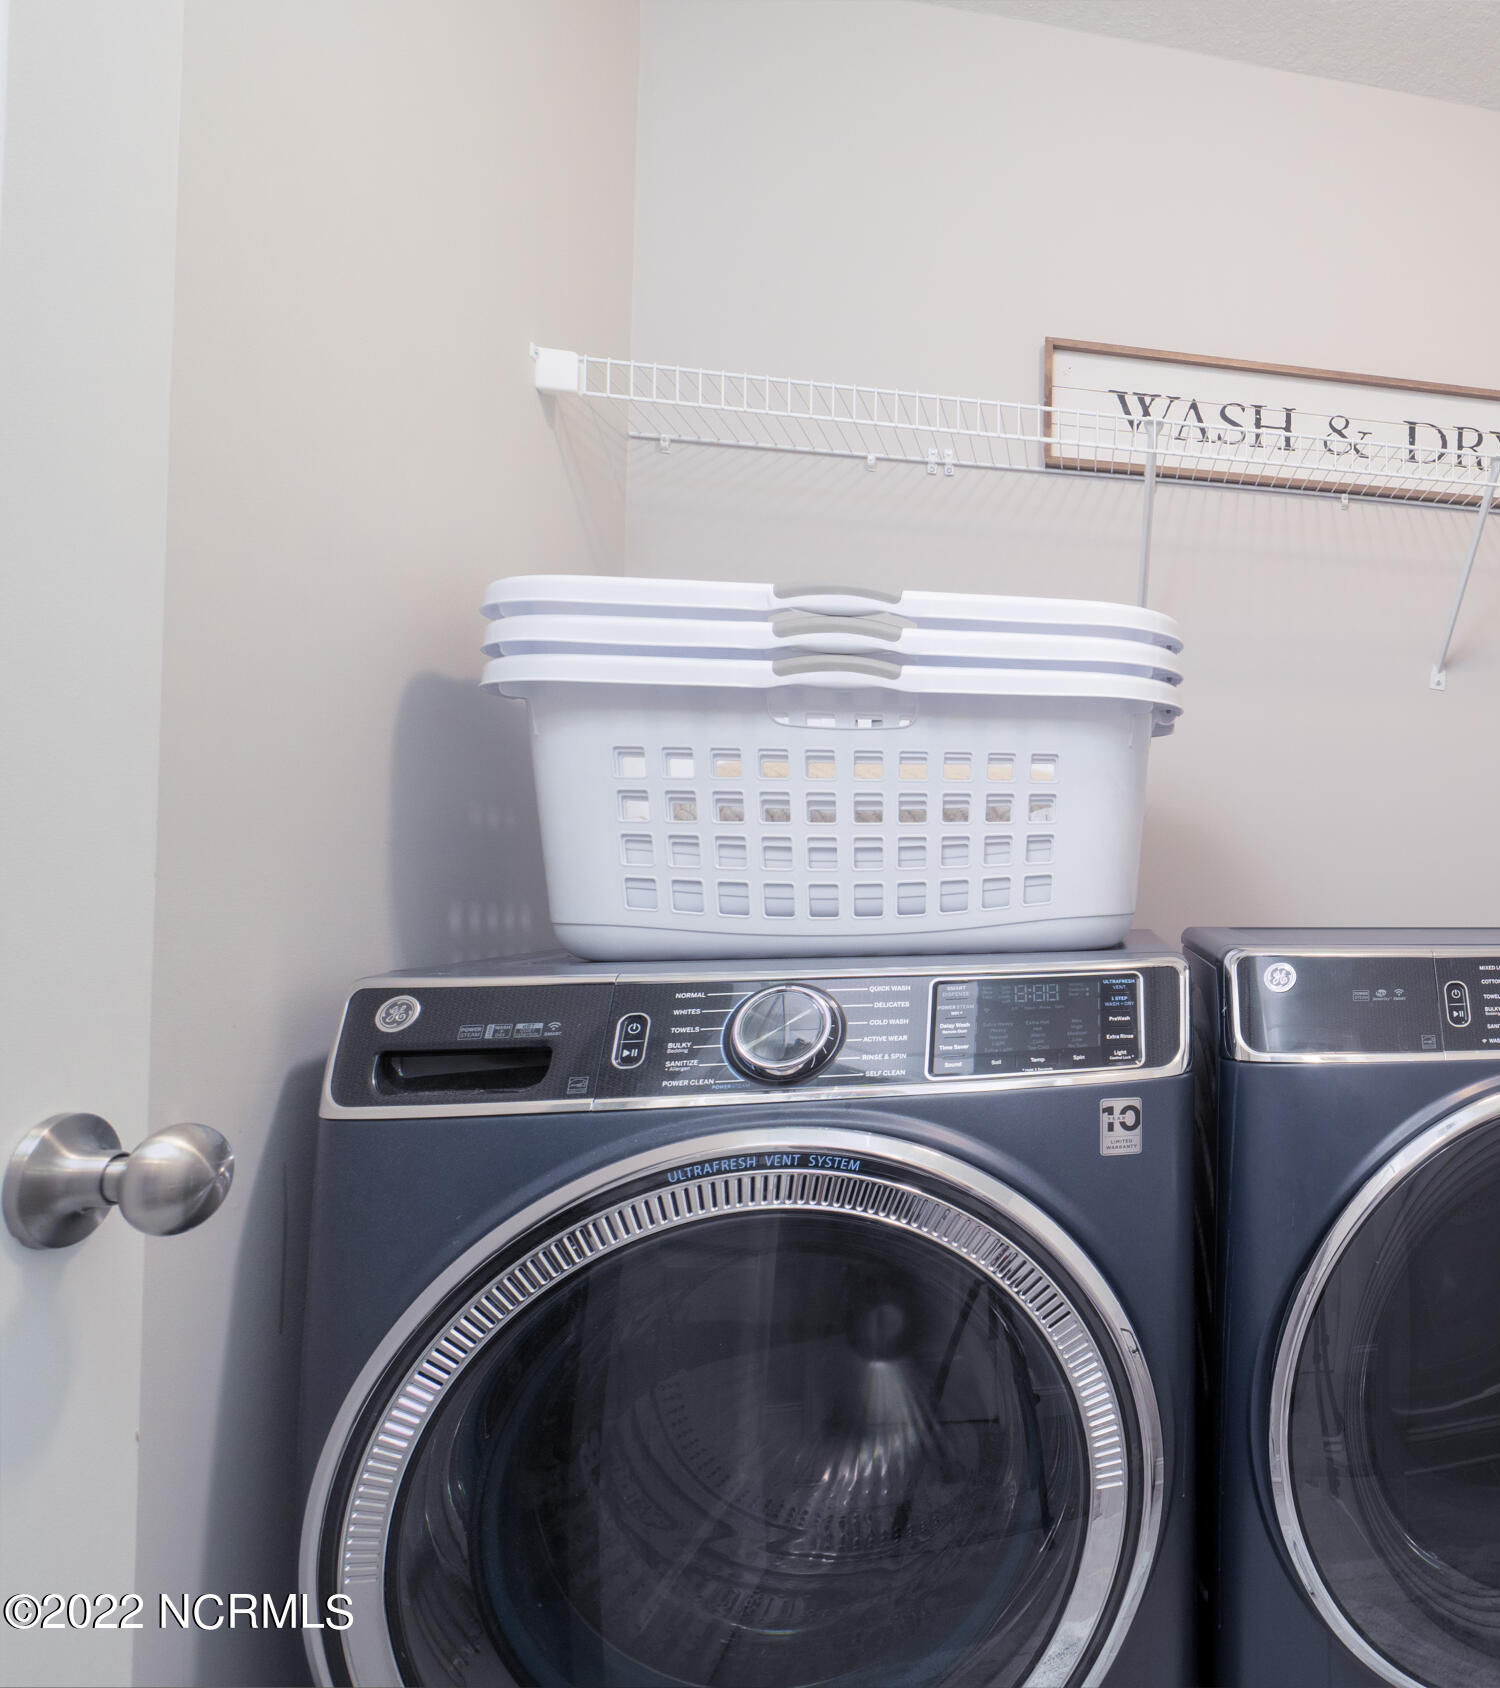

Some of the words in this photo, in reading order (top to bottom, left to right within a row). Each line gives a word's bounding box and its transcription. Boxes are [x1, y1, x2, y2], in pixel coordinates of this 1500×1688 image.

[1109, 390, 1296, 452] WASH
[1323, 415, 1372, 460] &
[869, 985, 890, 993] QUICK
[1102, 1104, 1141, 1132] 10
[667, 1155, 757, 1183] ULTRAFRESH
[765, 1154, 801, 1167] VENT
[808, 1154, 861, 1171] SYSTEM
